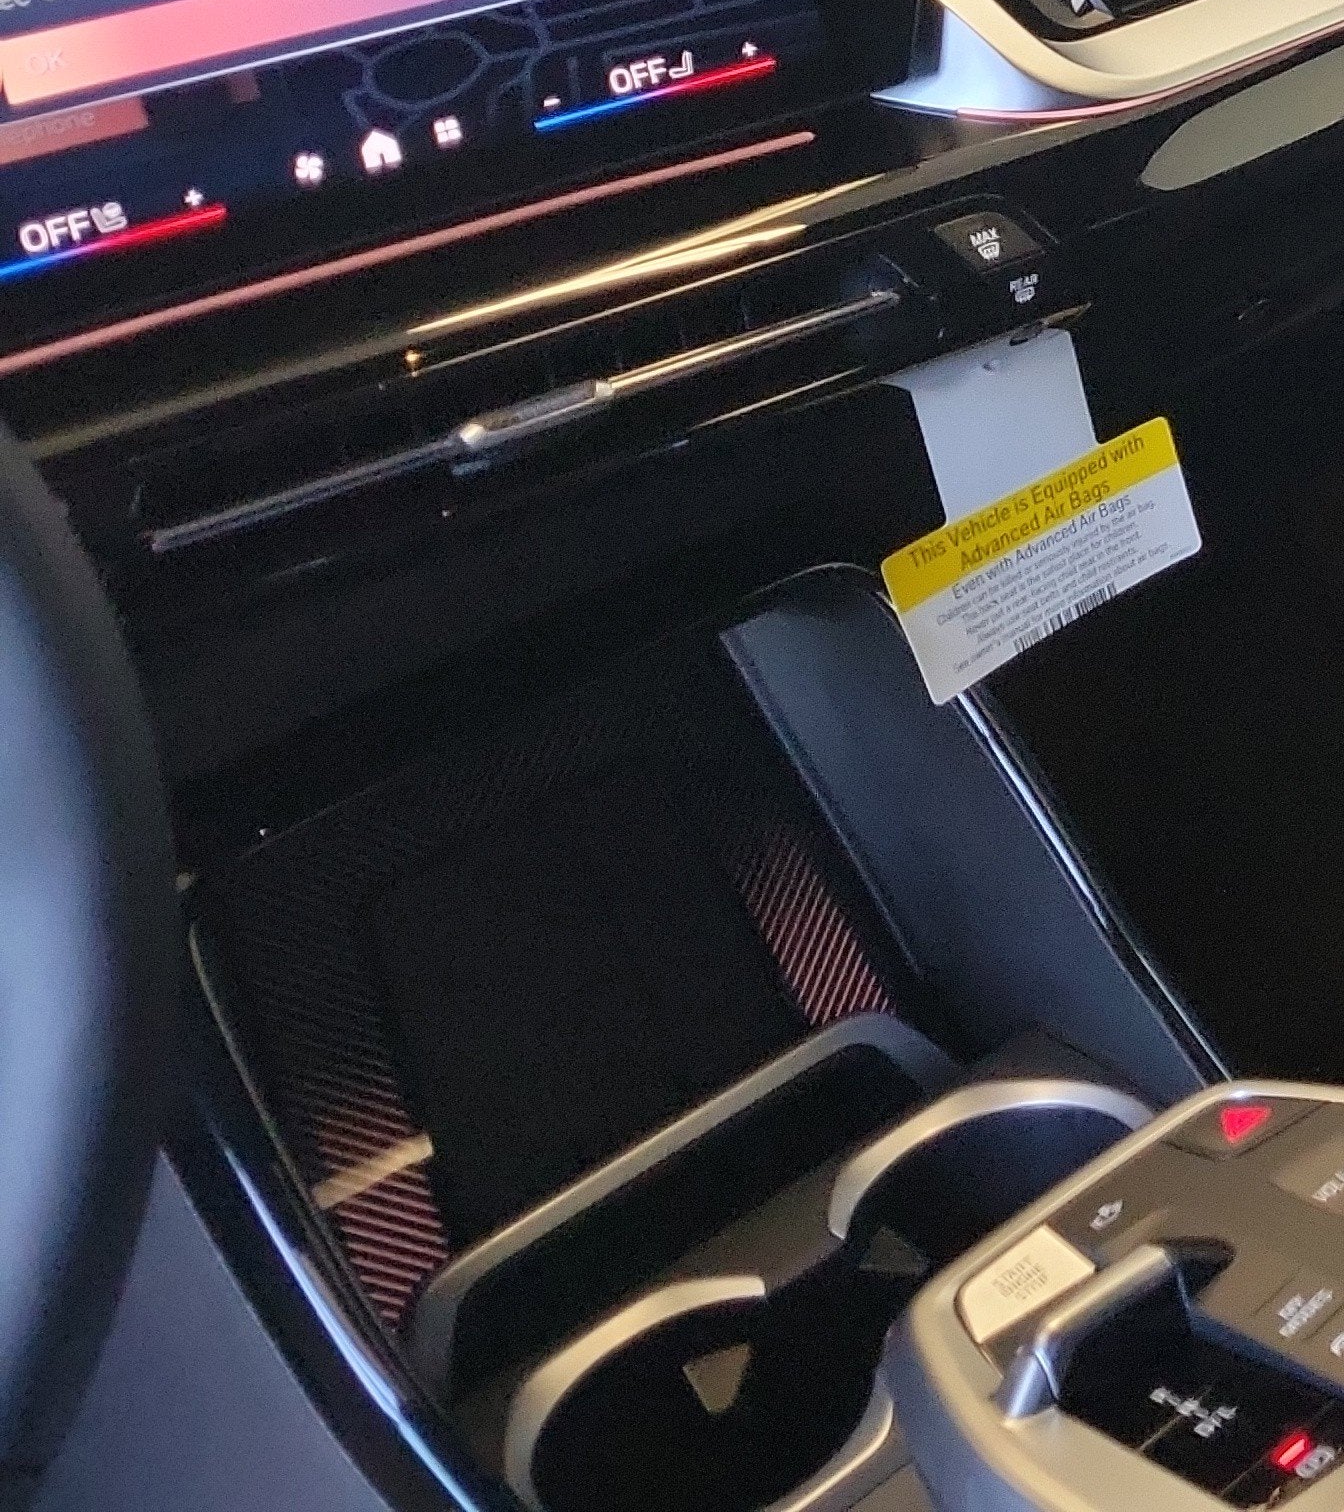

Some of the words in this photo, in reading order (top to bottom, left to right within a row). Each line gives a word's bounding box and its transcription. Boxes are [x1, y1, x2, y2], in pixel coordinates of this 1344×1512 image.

[28, 50, 66, 76] OK
[609, 56, 667, 95] OFF
[18, 208, 91, 255] OFF
[969, 227, 1001, 248] MAX
[909, 539, 945, 568] This
[947, 506, 1010, 548] Vehicle
[1012, 496, 1027, 512] is
[1030, 454, 1108, 506] Equipped
[1109, 435, 1144, 461] with
[957, 514, 1041, 569] Advanced
[1040, 501, 1065, 522] Air
[1068, 478, 1110, 512] Bags
[951, 573, 984, 598] Even
[984, 556, 1013, 579] with
[1013, 521, 1077, 562] Advanced
[1077, 511, 1096, 526] Air
[1097, 492, 1130, 518] Bags
